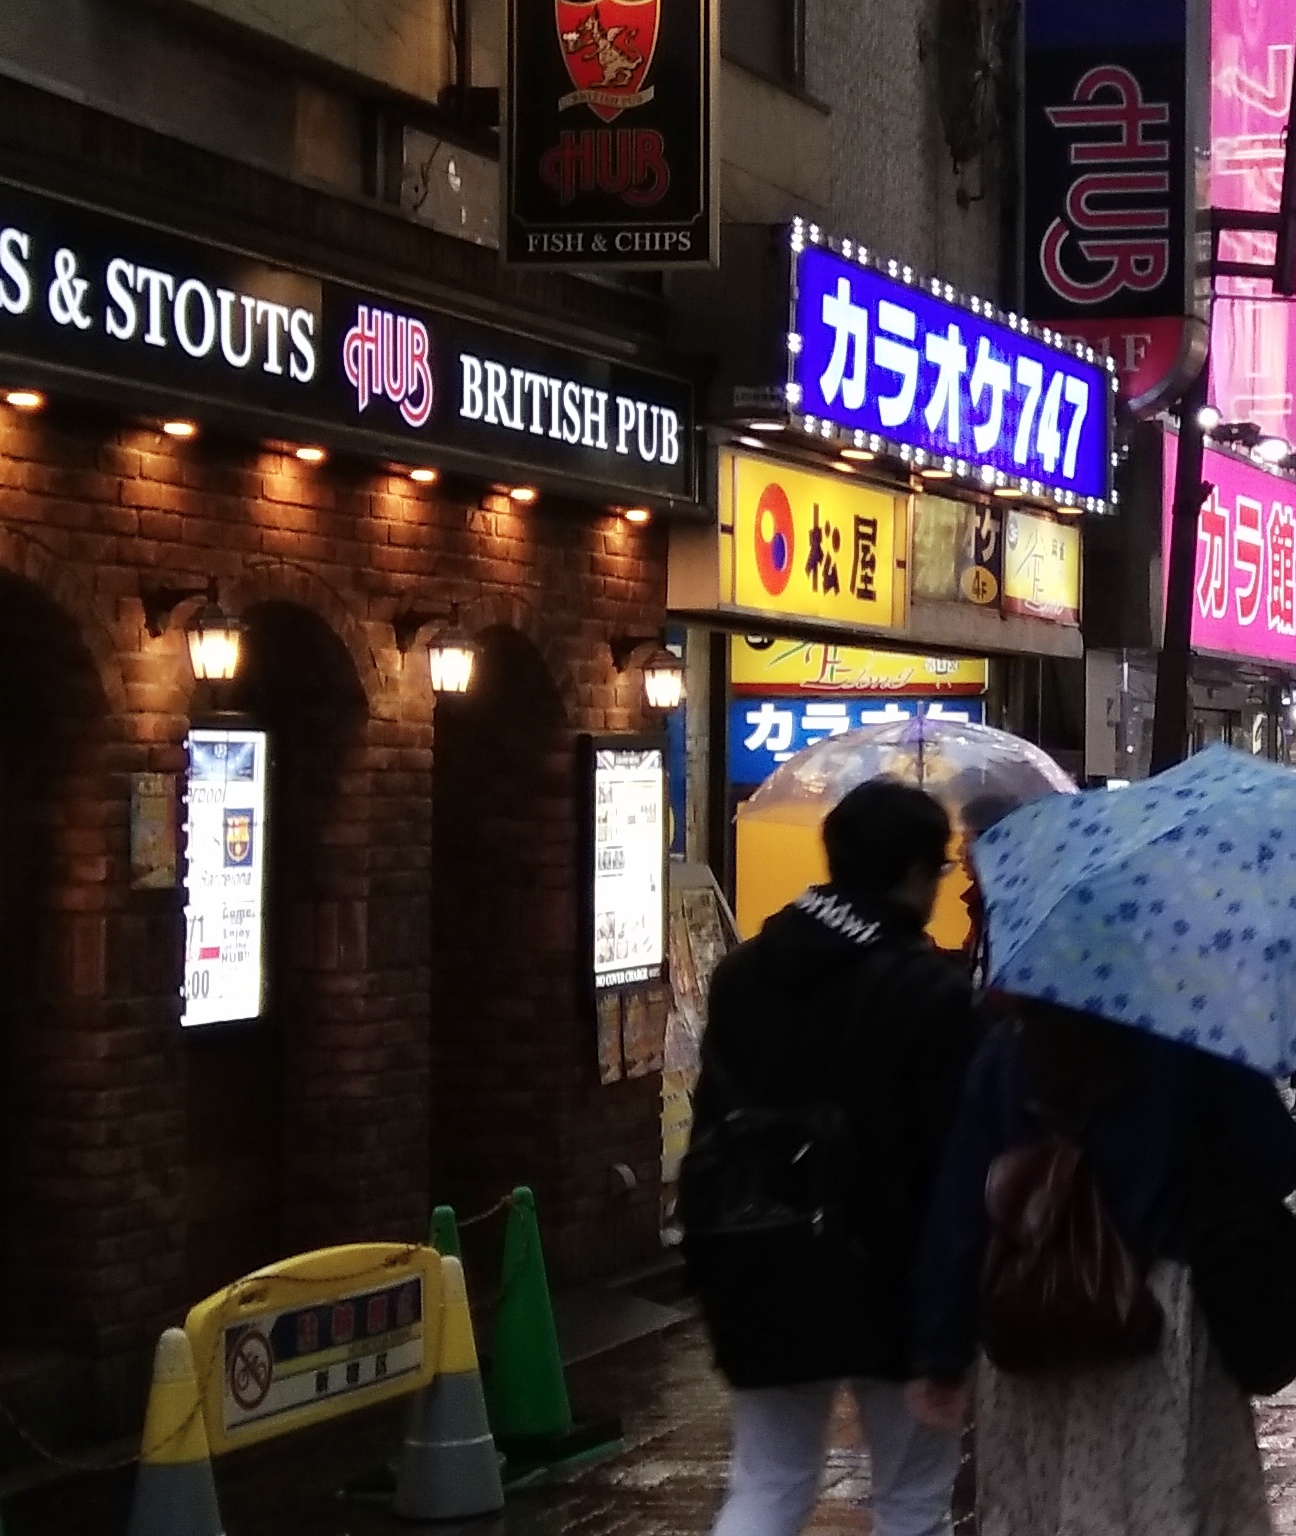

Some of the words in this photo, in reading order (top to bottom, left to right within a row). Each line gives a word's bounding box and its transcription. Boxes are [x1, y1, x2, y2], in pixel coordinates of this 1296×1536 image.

[542, 128, 671, 208] HUB
[1040, 64, 1170, 304] HUB
[527, 234, 584, 253] FISH
[591, 234, 608, 252] &
[615, 230, 692, 251] CHIPS
[48, 247, 93, 329] &
[105, 255, 316, 383] STOUTS
[342, 303, 434, 428] HUB
[459, 352, 609, 452] BRITISH
[617, 396, 680, 466] PUB
[806, 503, 880, 604] 松屋
